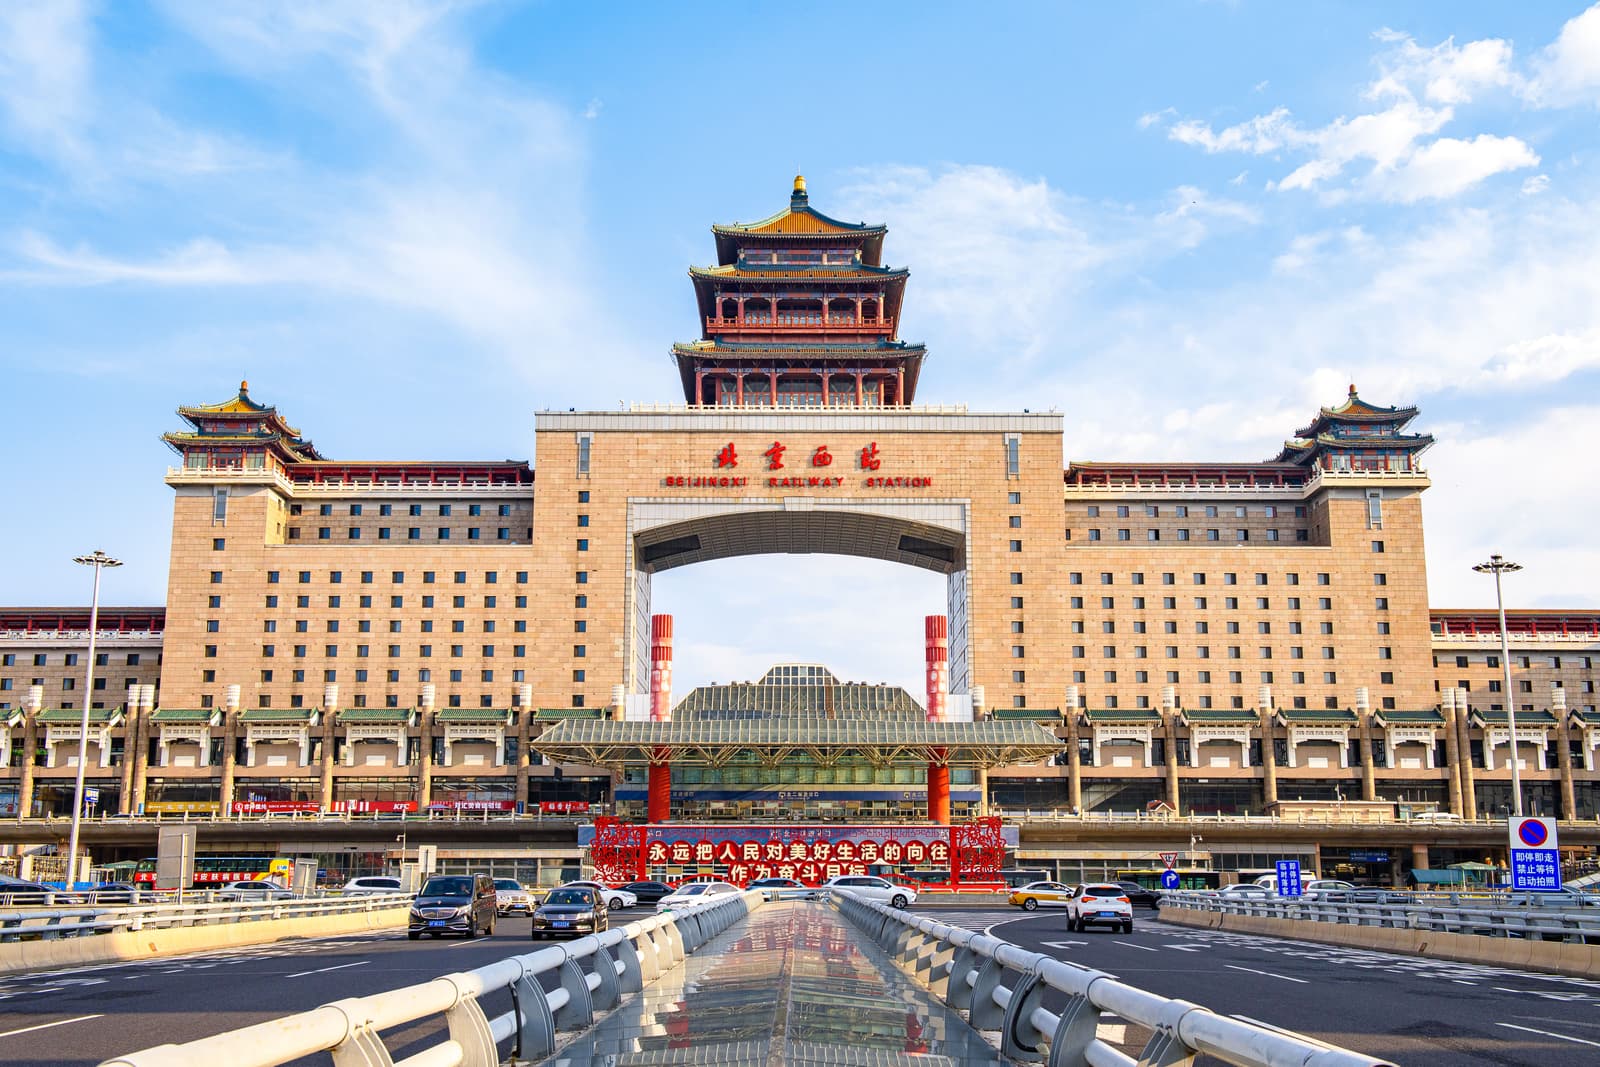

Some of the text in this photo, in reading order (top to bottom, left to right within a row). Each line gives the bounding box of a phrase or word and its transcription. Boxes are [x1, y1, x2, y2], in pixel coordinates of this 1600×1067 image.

[717, 442, 881, 470] 北京西站
[665, 477, 932, 487] BEIJINGXI RAILWAY STATION
[649, 843, 948, 861] 永远把人民对美好生活的向往
[1516, 853, 1554, 862] 即停即走
[730, 864, 867, 882] 作为奋斗目标
[1517, 864, 1554, 874] 禁止等待
[1289, 863, 1298, 894] 即停即走
[1518, 876, 1555, 886] 自动拍照
